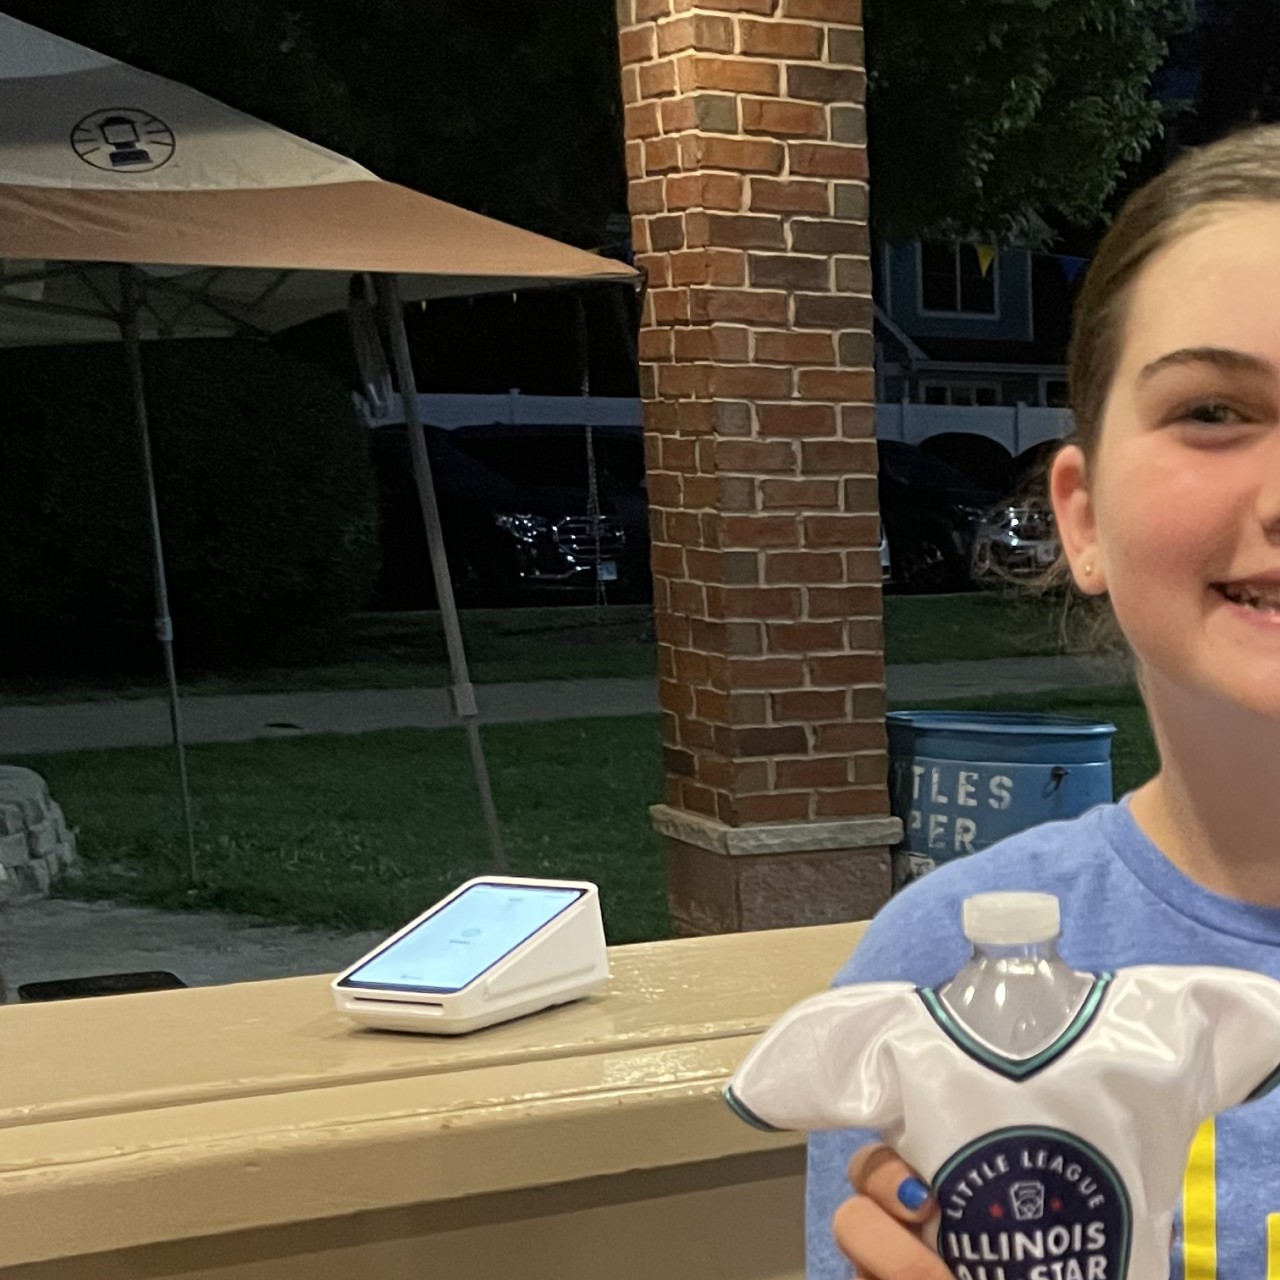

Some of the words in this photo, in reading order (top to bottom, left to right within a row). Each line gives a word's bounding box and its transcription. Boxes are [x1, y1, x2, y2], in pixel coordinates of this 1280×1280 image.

[947, 1154, 1010, 1220] LITTLE
[1020, 1150, 1105, 1210] LEAGUE
[949, 1221, 1107, 1261] ILLINOIS
